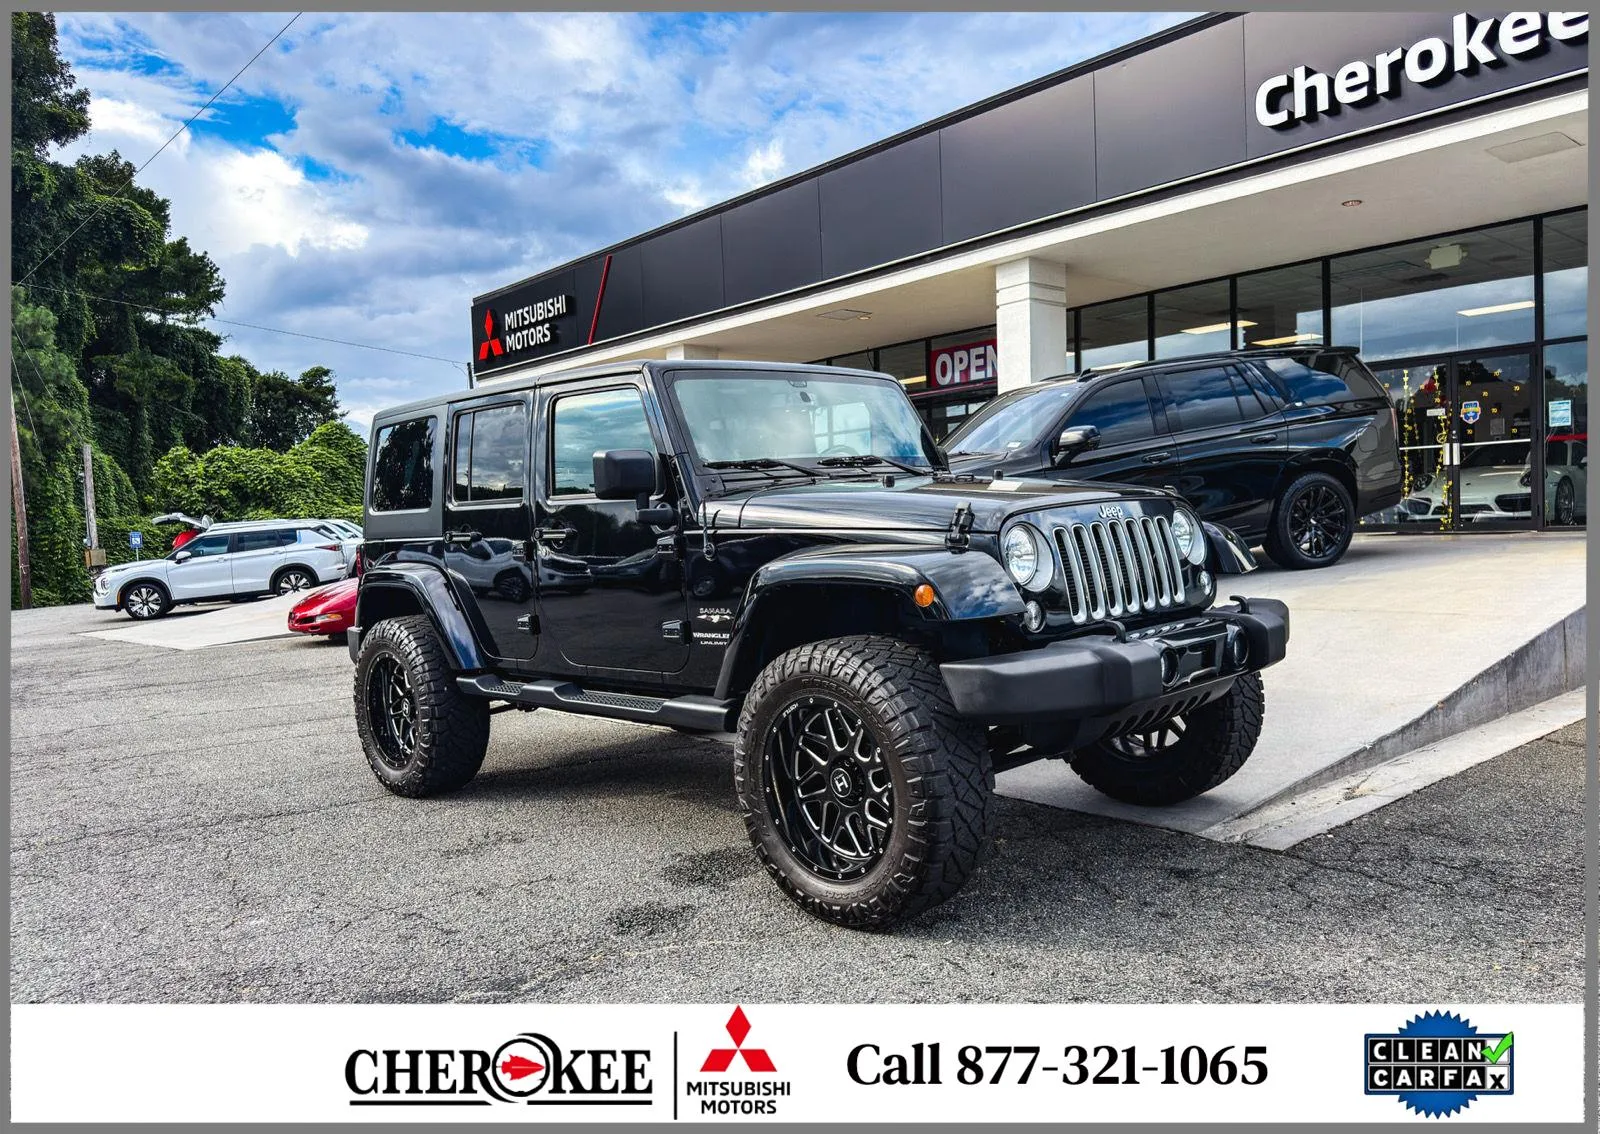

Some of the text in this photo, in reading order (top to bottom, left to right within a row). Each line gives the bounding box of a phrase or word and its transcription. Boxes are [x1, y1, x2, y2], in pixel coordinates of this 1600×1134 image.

[504, 294, 567, 331] MITSUBISHI
[505, 323, 551, 353] MOTORS
[1099, 505, 1123, 518] Jeep
